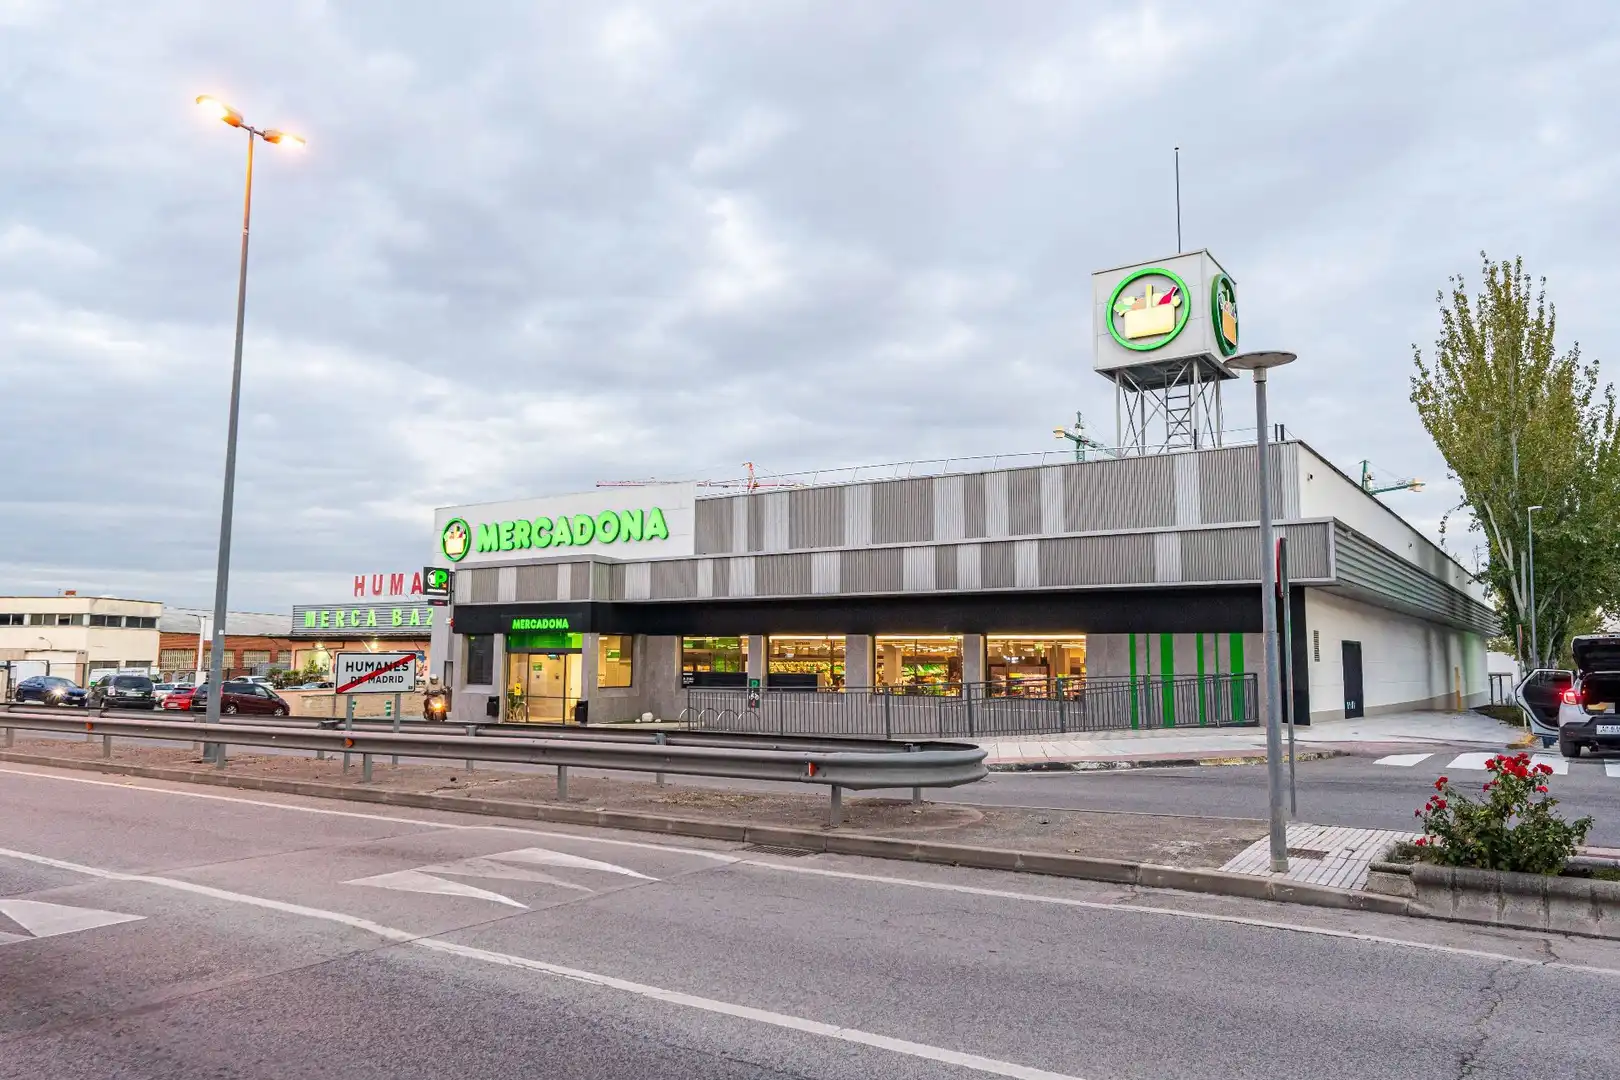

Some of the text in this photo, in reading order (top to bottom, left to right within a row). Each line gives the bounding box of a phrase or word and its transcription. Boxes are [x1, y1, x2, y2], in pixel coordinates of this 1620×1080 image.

[476, 507, 669, 552] MERCADONA
[304, 609, 377, 628] MERCA
[512, 618, 570, 630] MERCADONA
[345, 661, 409, 673] HUMANES
[368, 675, 404, 684] MADRID
